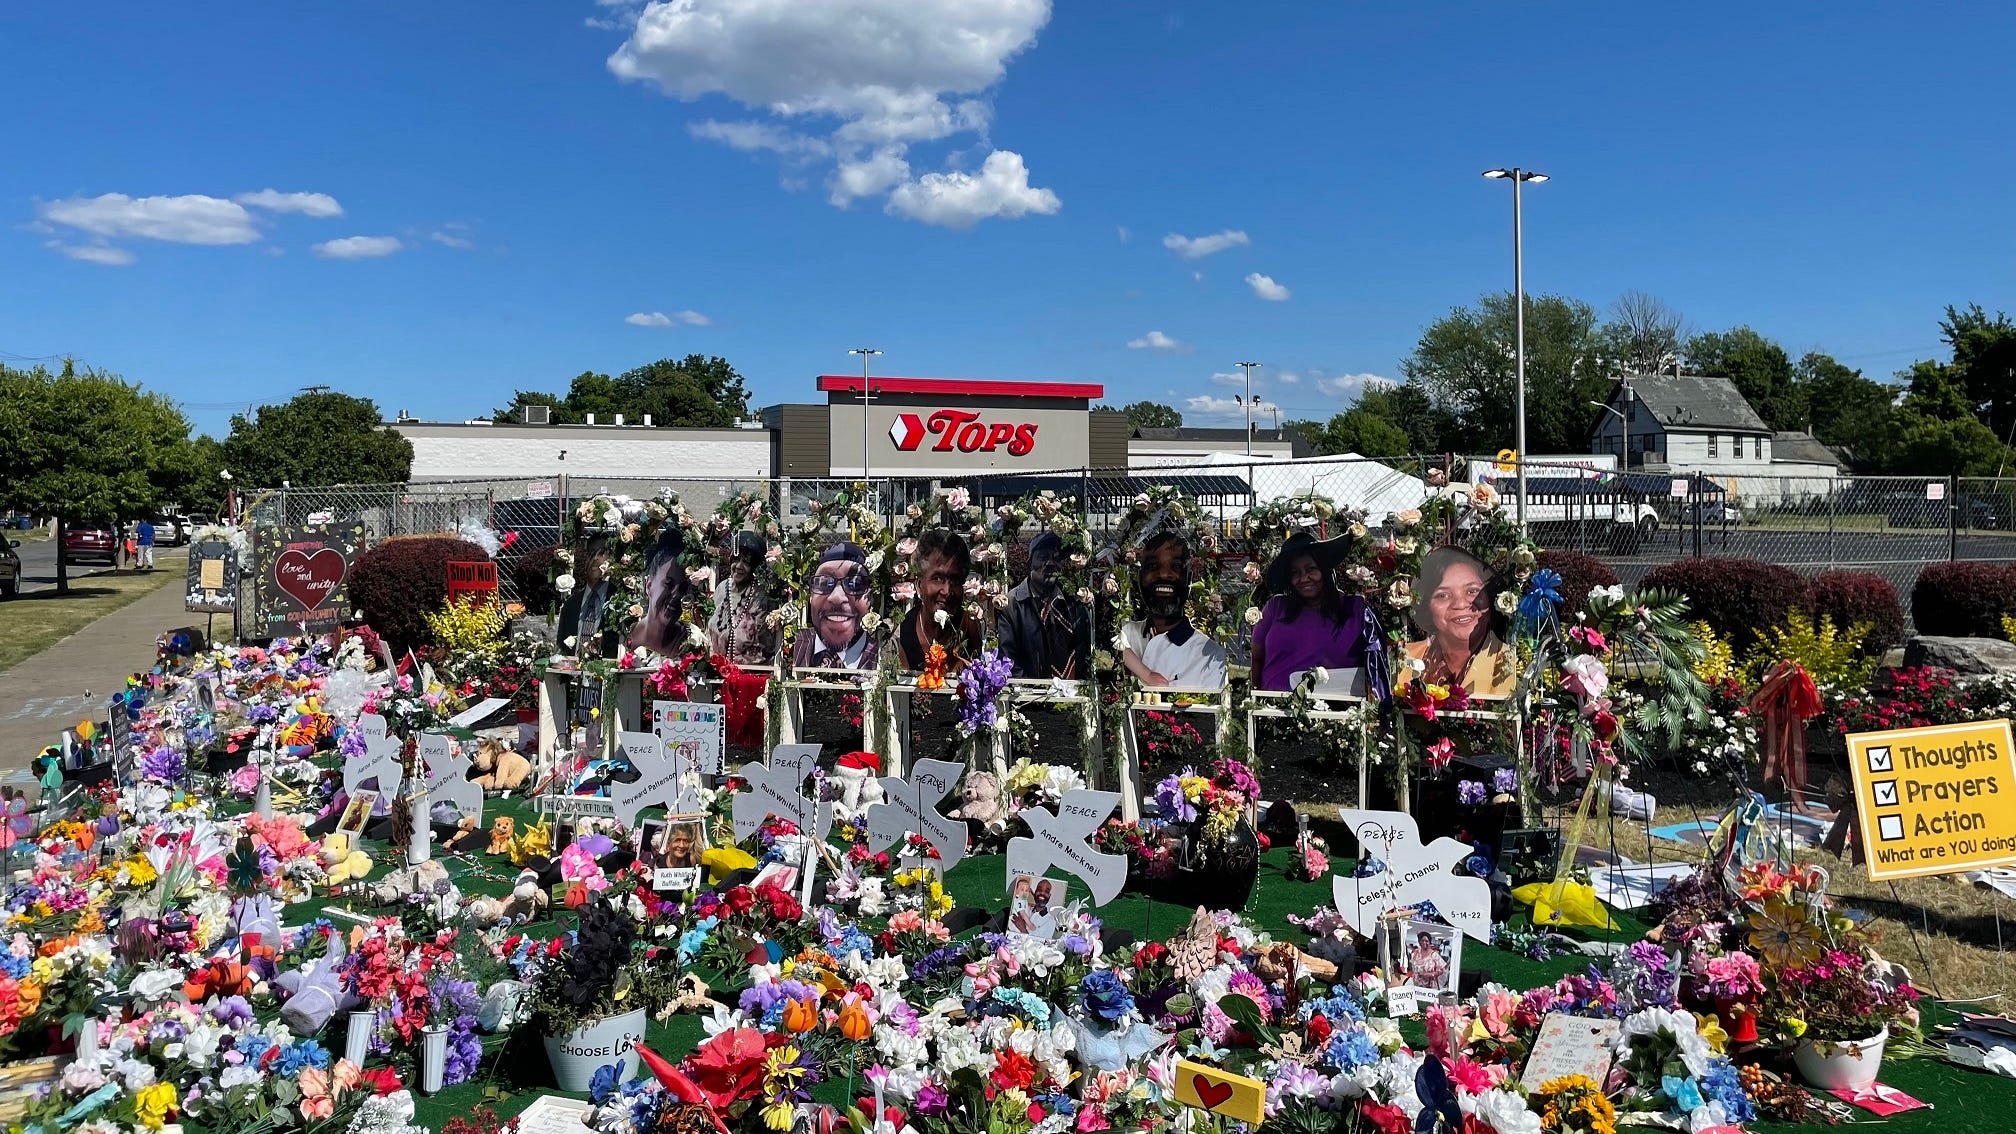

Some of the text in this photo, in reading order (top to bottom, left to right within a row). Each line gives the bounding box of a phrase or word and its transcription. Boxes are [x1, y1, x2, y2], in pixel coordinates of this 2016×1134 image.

[1155, 458, 1182, 467] FOOD
[282, 562, 305, 574] love
[450, 563, 495, 582] Stop! No!
[297, 570, 312, 580] and
[307, 579, 336, 595] unity
[268, 613, 286, 622] from
[287, 608, 339, 622] COMMUNITY
[365, 728, 382, 736] PEACE
[629, 746, 653, 754] PEACE
[1899, 740, 1998, 769] Thoughts
[774, 759, 802, 769] PEACE
[915, 775, 944, 788] PEACE
[622, 772, 677, 807] Heyward Patterson
[760, 783, 776, 798] Ruth
[1905, 776, 1999, 803] Prayers
[583, 803, 592, 811] YET
[594, 804, 601, 812] TO
[1065, 805, 1099, 818] PEACE
[893, 794, 949, 842] Margus Morrison
[1914, 810, 1986, 837] Action
[872, 832, 892, 841] 5-14-22
[1040, 829, 1064, 849] Andre
[1363, 830, 1406, 840] PEACE
[1877, 835, 2016, 864] What are YOU doing
[1358, 861, 1441, 906] Celesne Chaney
[1451, 911, 1481, 919] 5-14-22
[1568, 1022, 1592, 1030] GOD
[560, 1044, 610, 1057] CHOOSE
